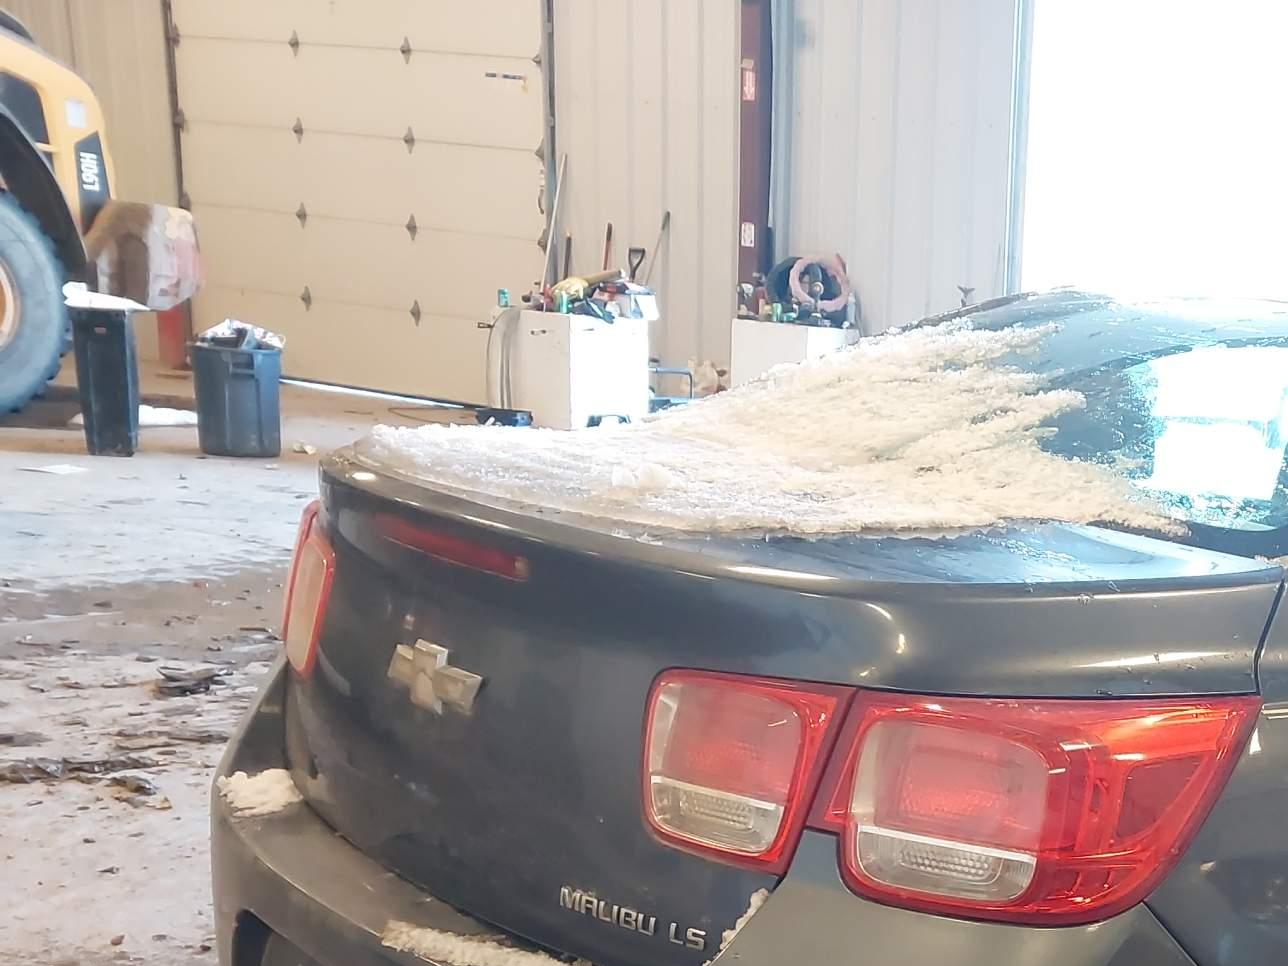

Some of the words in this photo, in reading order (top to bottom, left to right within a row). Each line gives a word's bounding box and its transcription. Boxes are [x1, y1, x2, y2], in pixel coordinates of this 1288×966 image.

[79, 151, 101, 192] L90H
[559, 885, 657, 937] MALIBU
[668, 921, 707, 951] LS
